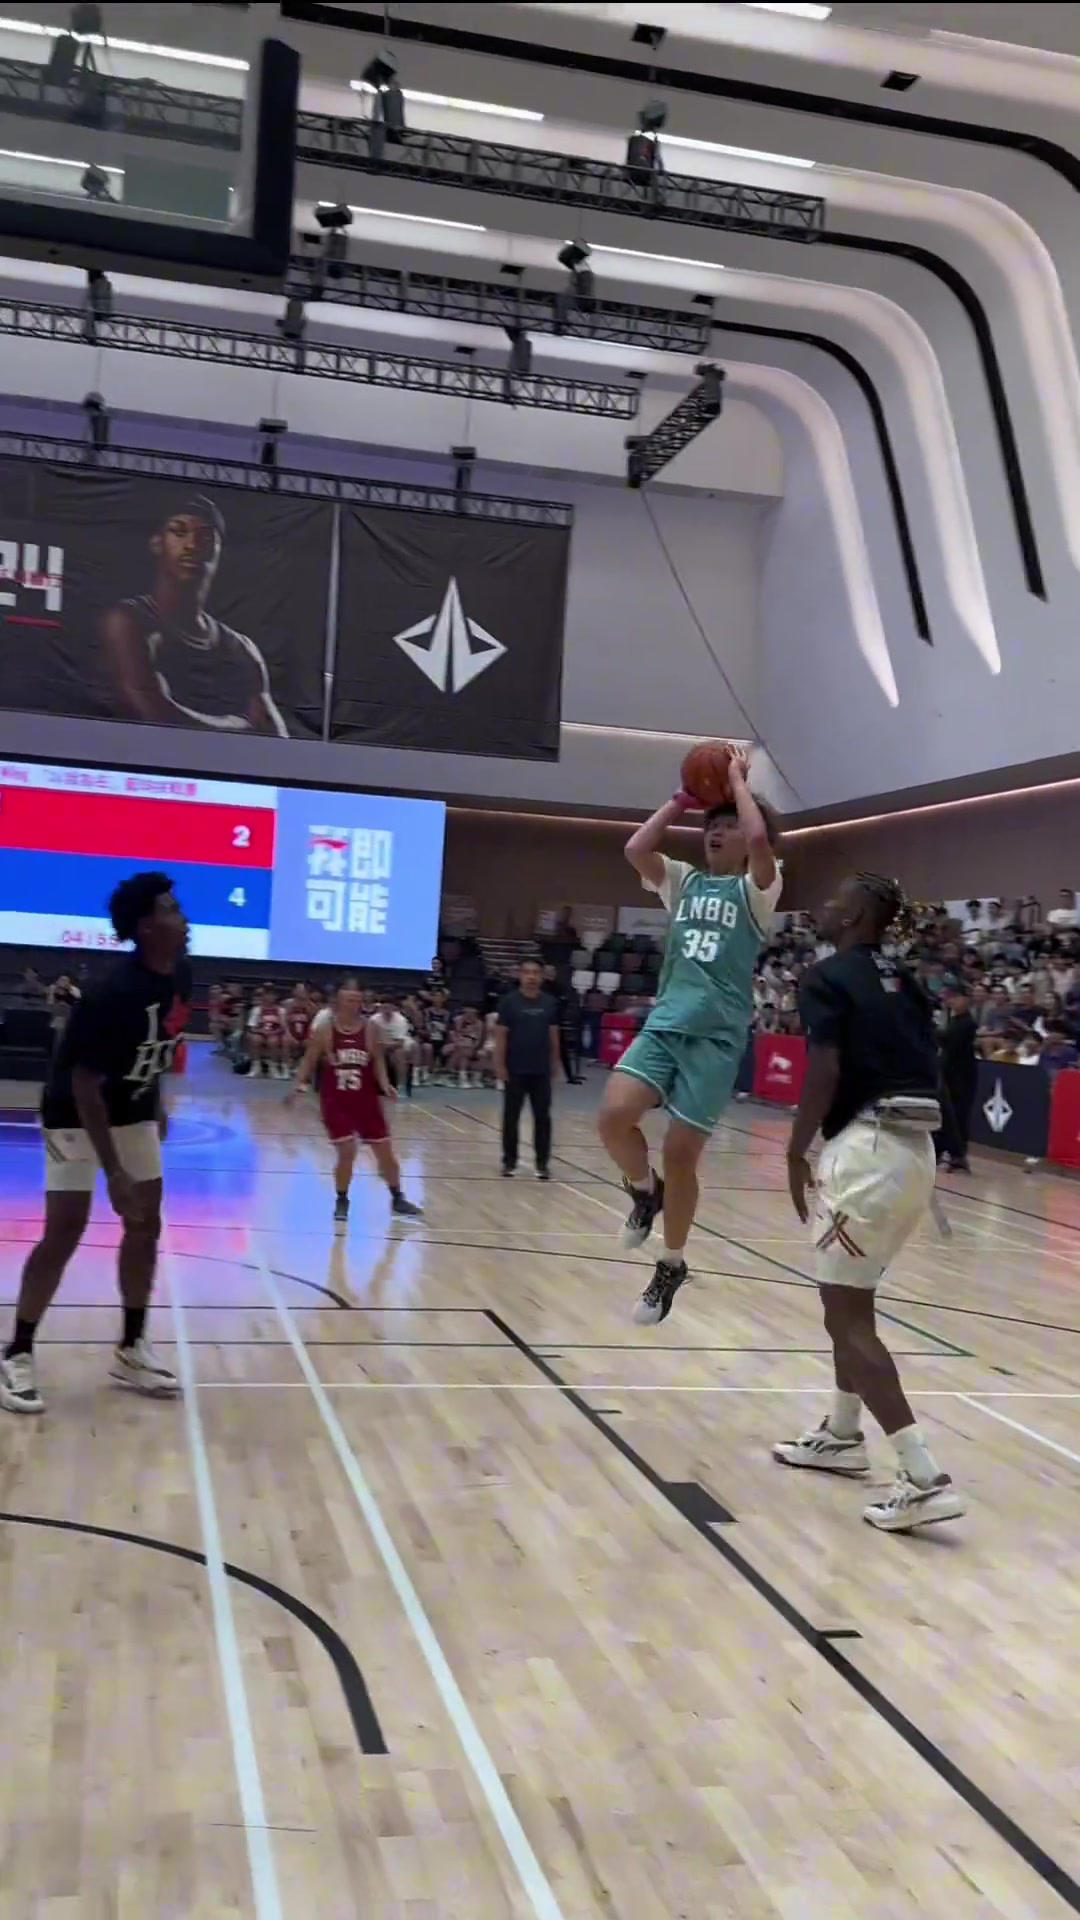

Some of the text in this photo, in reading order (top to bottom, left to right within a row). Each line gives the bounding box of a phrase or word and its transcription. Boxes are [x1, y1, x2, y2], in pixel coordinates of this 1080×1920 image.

[232, 825, 251, 848] 2
[228, 887, 247, 907] 4
[674, 896, 738, 929] LNBB
[681, 928, 721, 962] 35
